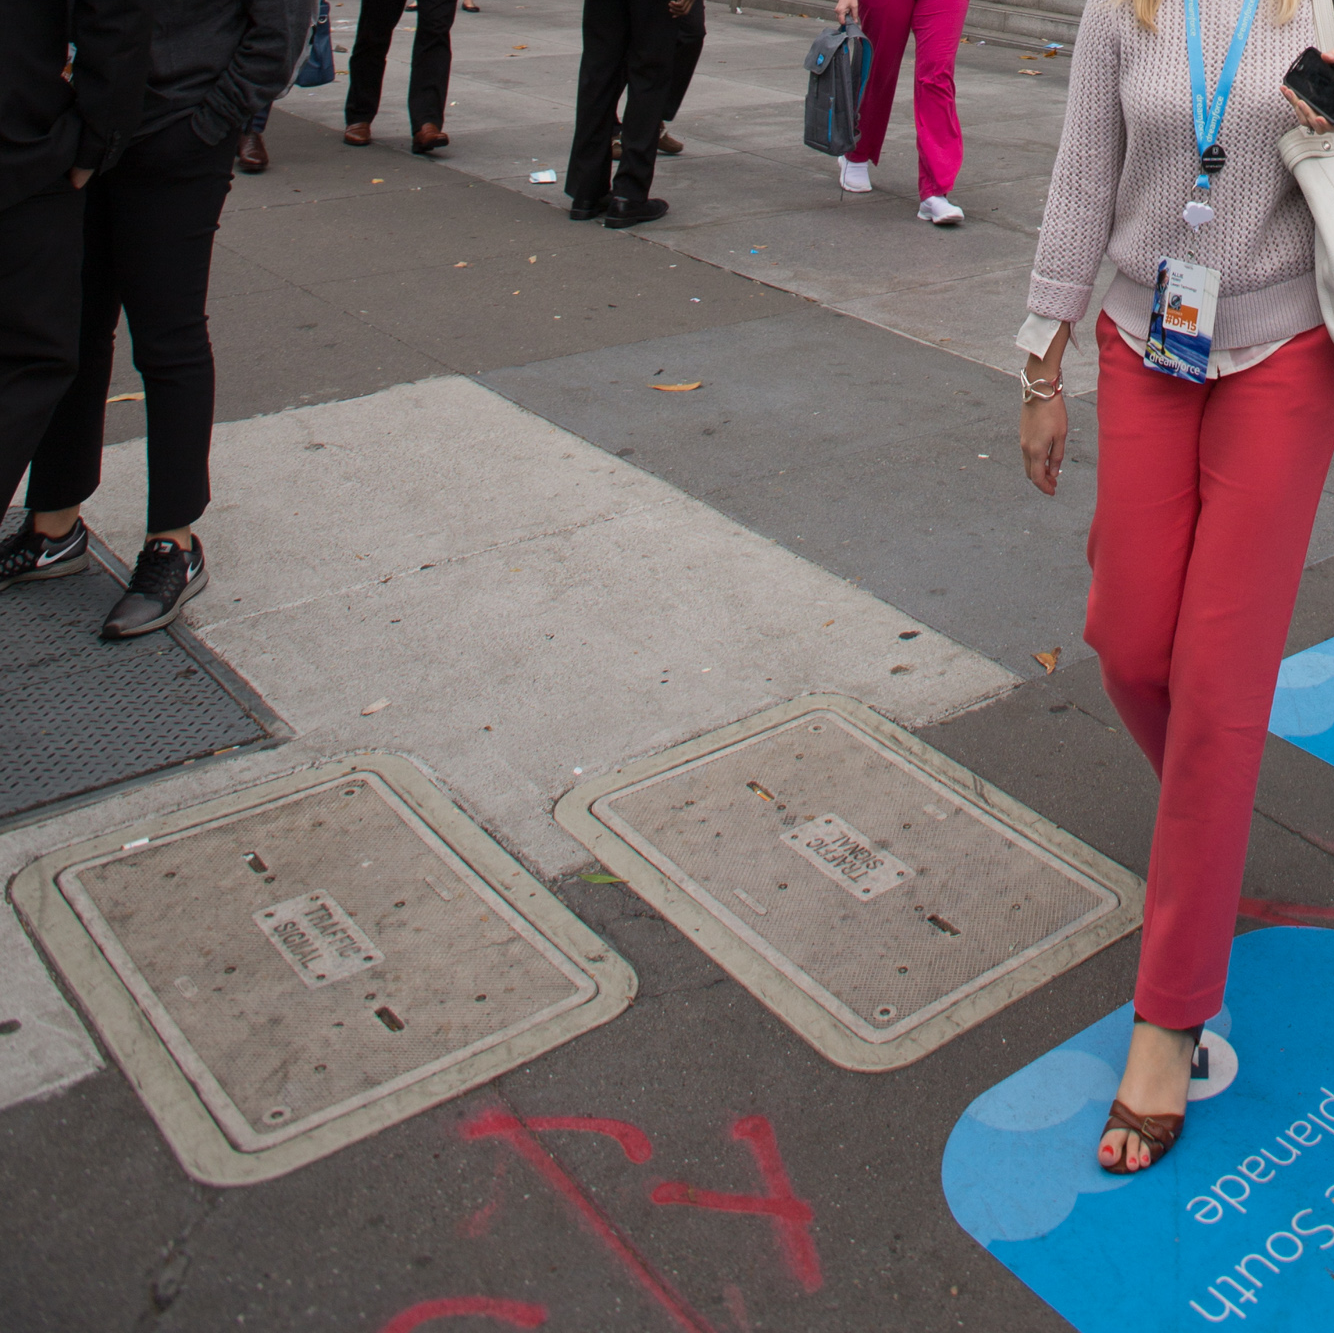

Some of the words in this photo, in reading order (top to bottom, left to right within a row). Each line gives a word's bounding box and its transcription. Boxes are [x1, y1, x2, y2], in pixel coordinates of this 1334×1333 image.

[1205, 95, 1225, 143] dreamforce
[1164, 314, 1198, 332] #DF15
[1148, 352, 1202, 376] dreamforce
[805, 837, 869, 883] TRAFFIC
[831, 831, 885, 871] SIGNAL
[273, 921, 324, 970] SIGNAL
[304, 902, 362, 958] TRAFFIC
